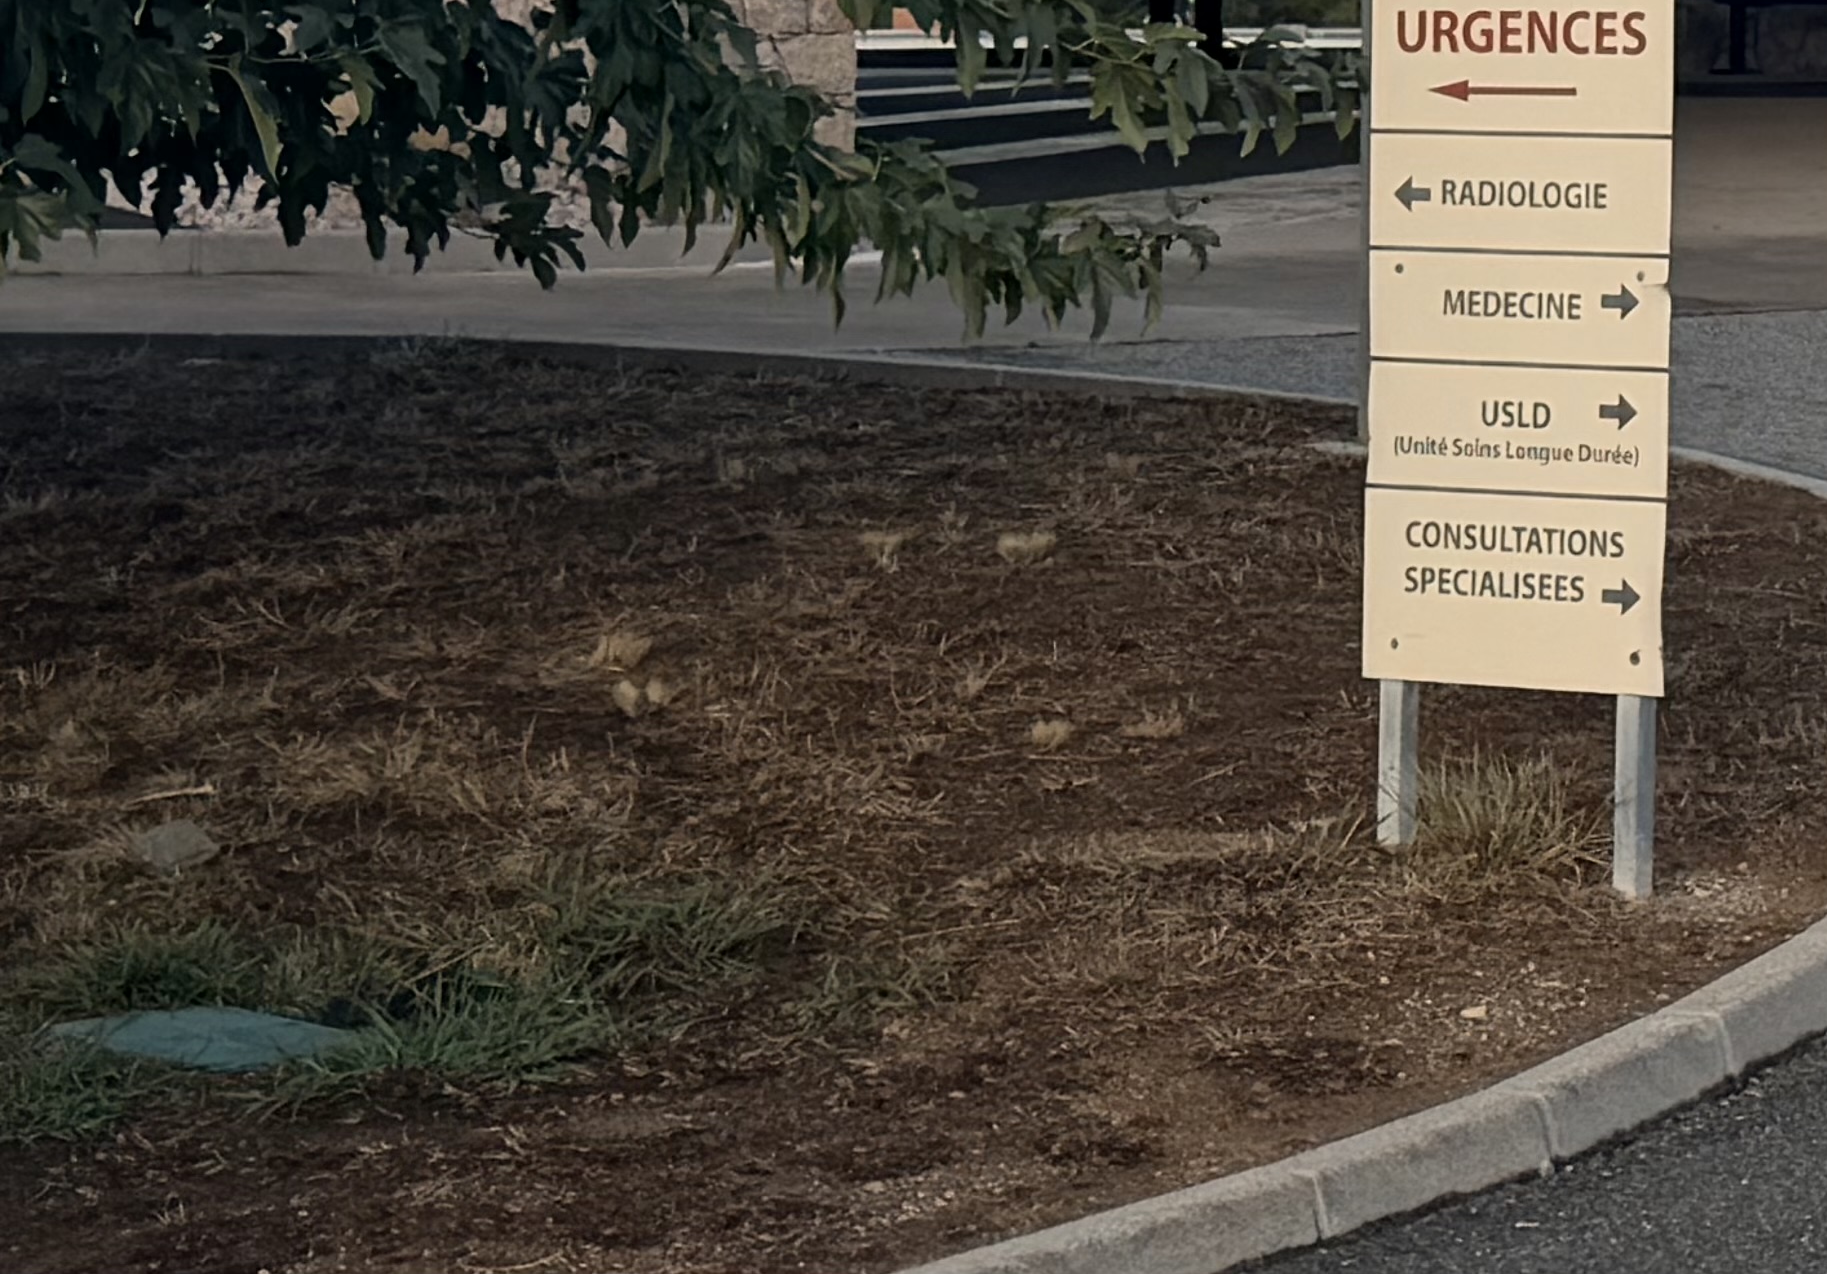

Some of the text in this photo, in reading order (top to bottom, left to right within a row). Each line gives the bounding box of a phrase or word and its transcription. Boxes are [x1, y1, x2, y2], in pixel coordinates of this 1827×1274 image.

[1396, 9, 1647, 56] URGENCES
[1440, 178, 1608, 209] RADIOLOGIE
[1442, 288, 1582, 320] MEDECINE
[1480, 400, 1551, 429] USLD
[1394, 435, 1640, 467] (Unité Soins Longue Durée)
[1405, 520, 1625, 558] CONSULTATIONS
[1404, 566, 1585, 603] SPECIALISEES
